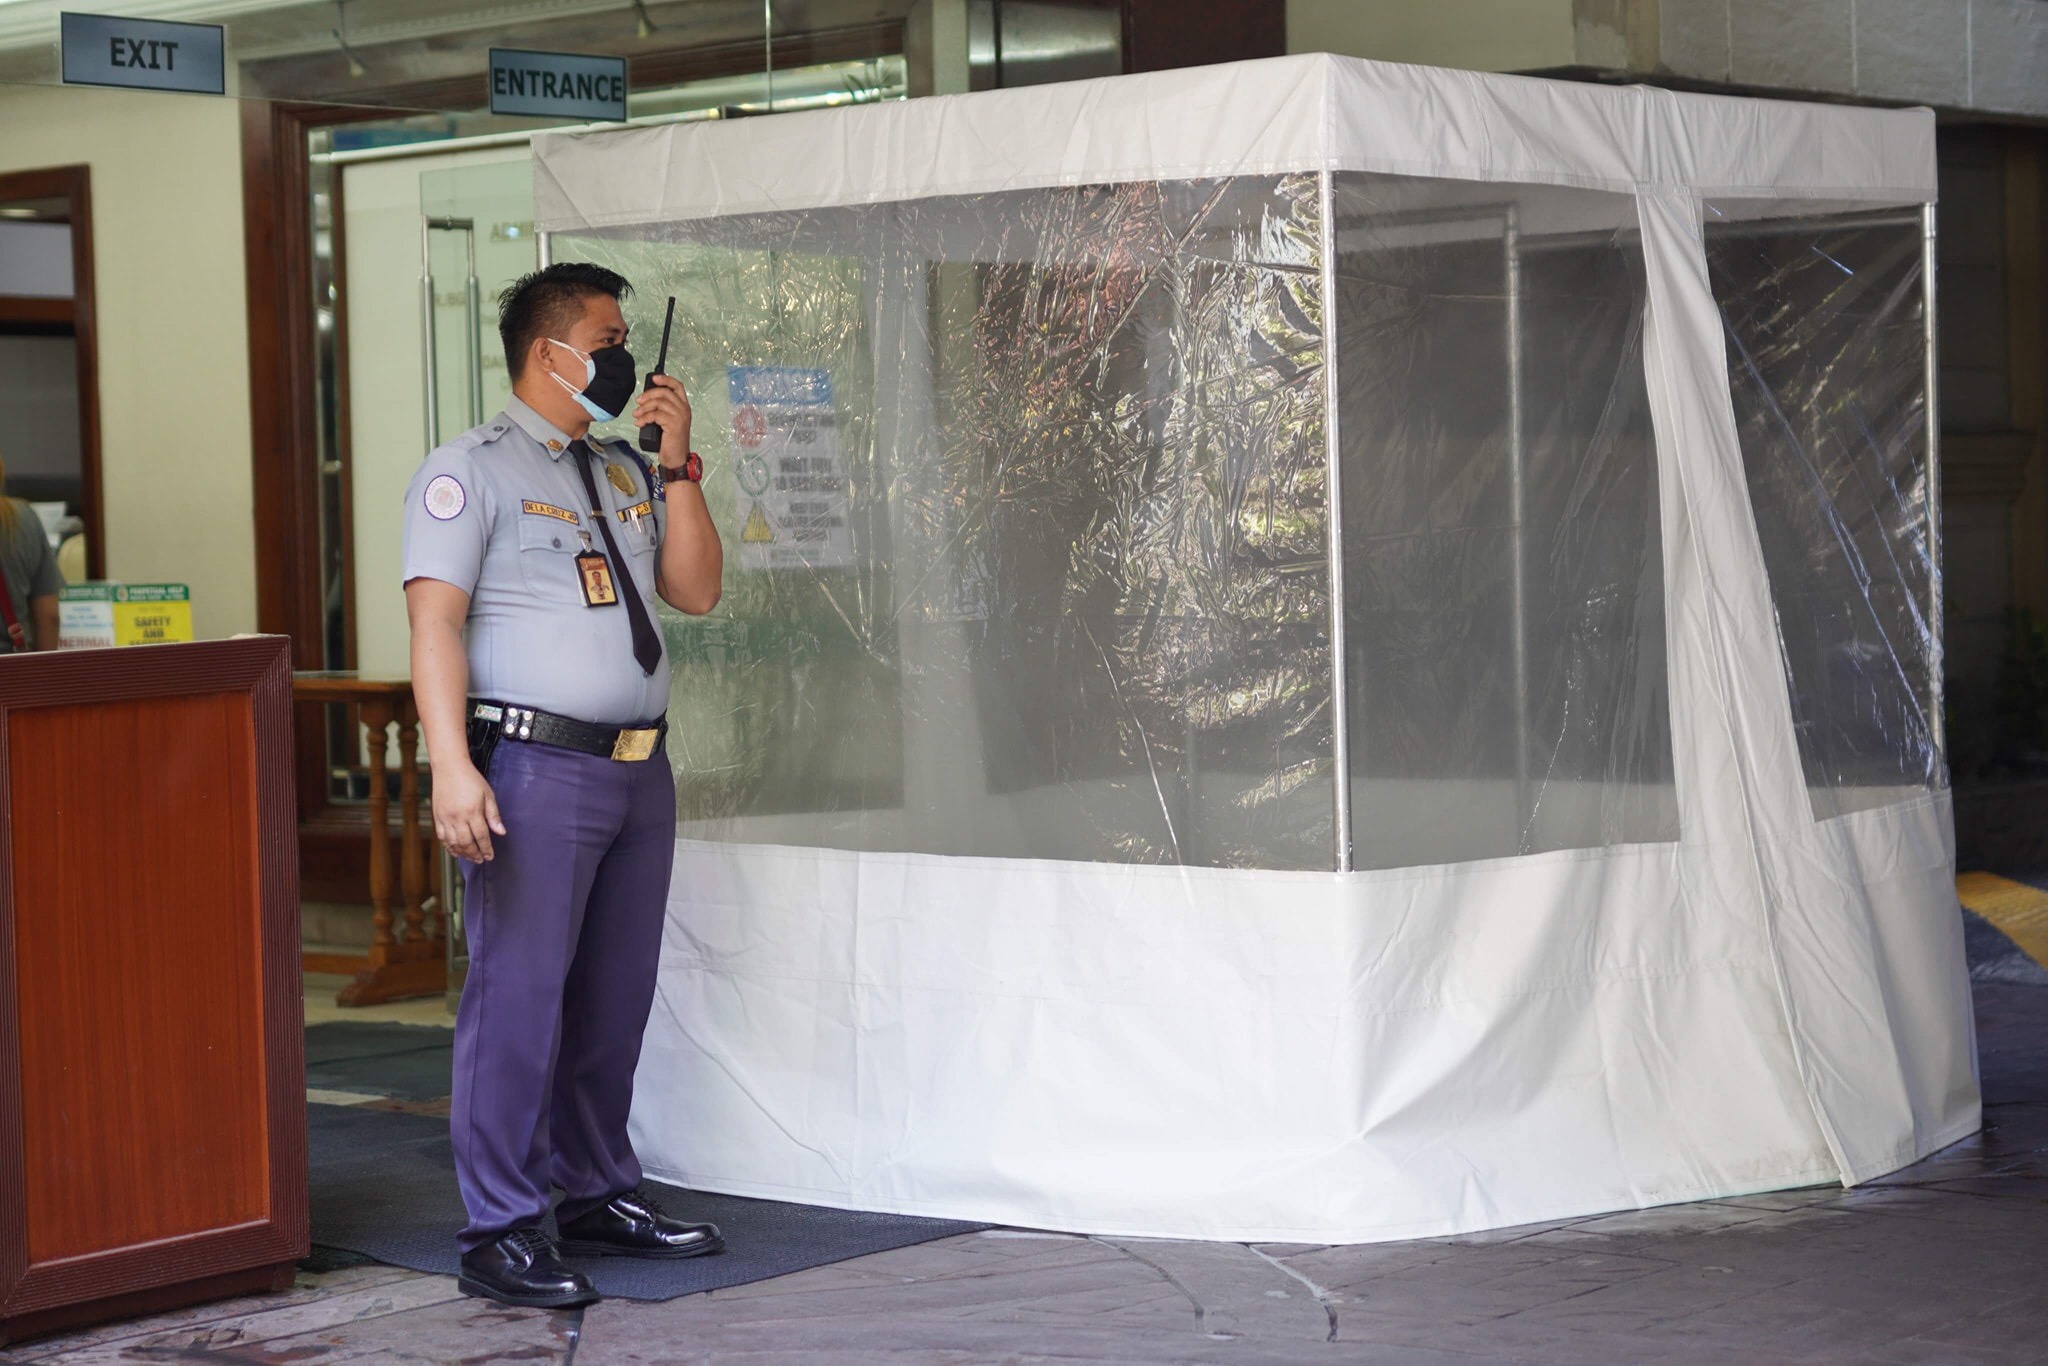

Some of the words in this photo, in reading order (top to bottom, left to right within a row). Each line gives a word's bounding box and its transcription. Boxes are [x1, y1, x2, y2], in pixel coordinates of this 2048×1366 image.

[110, 36, 178, 71] EXIT
[493, 67, 623, 103] ENTRANCE
[134, 616, 171, 627] SAFETY
[143, 627, 165, 638] AND
